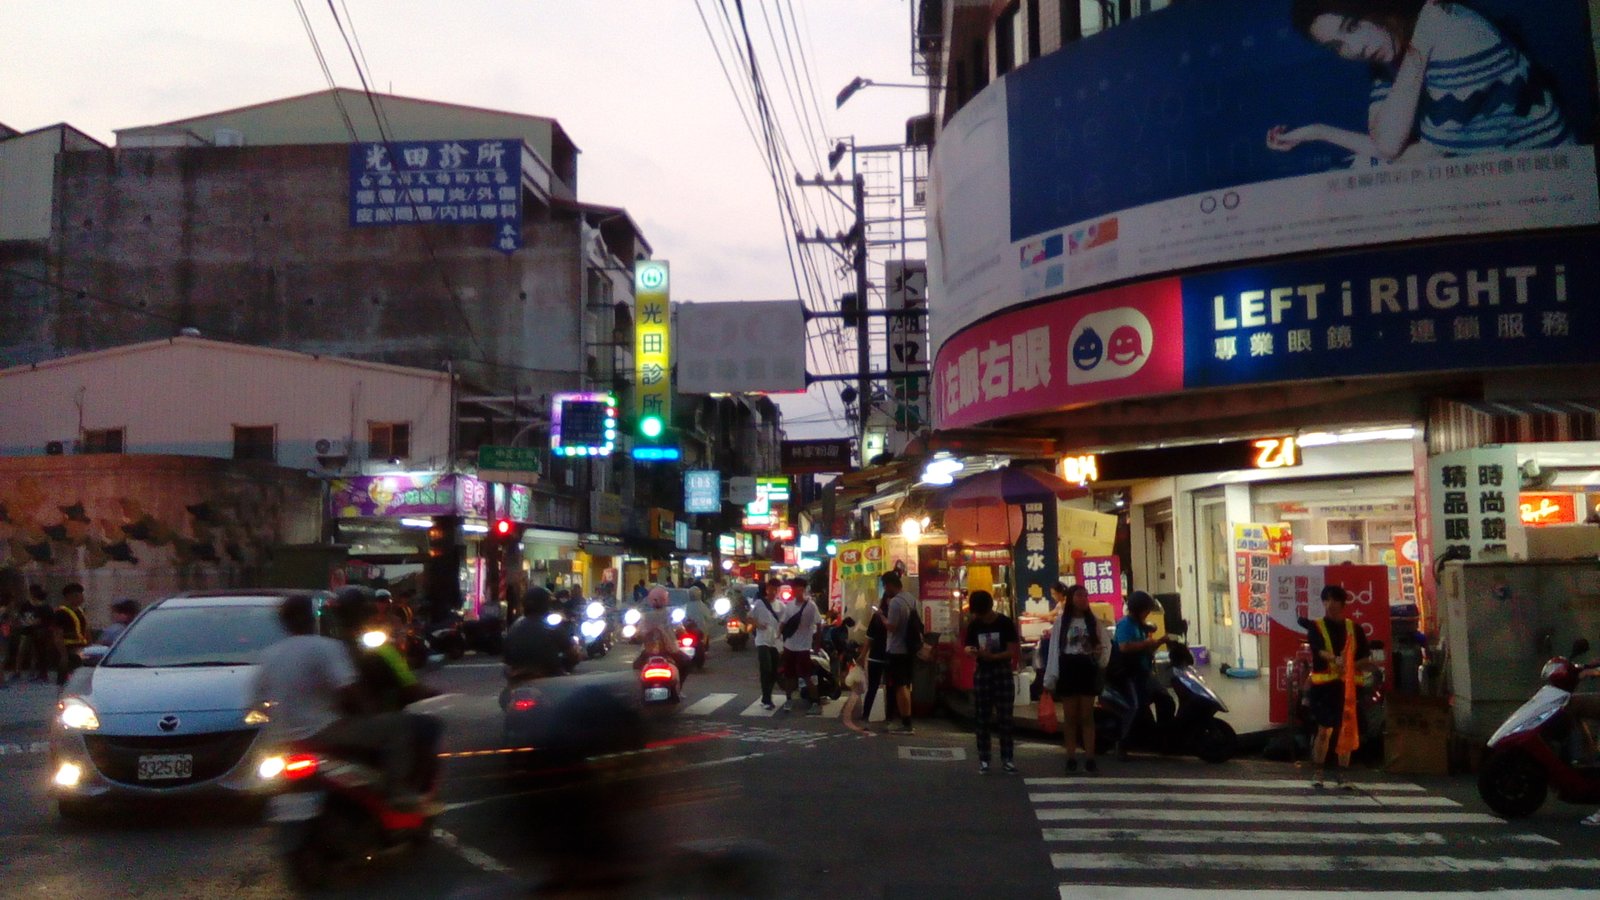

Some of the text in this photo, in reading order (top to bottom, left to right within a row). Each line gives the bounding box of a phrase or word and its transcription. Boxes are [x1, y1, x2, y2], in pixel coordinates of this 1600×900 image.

[1214, 265, 1566, 331] LEFT i RIGHT i
[642, 302, 663, 417] 光田診所
[946, 325, 1051, 417] 左眼右眼
[1084, 578, 1114, 595] 眼鏡
